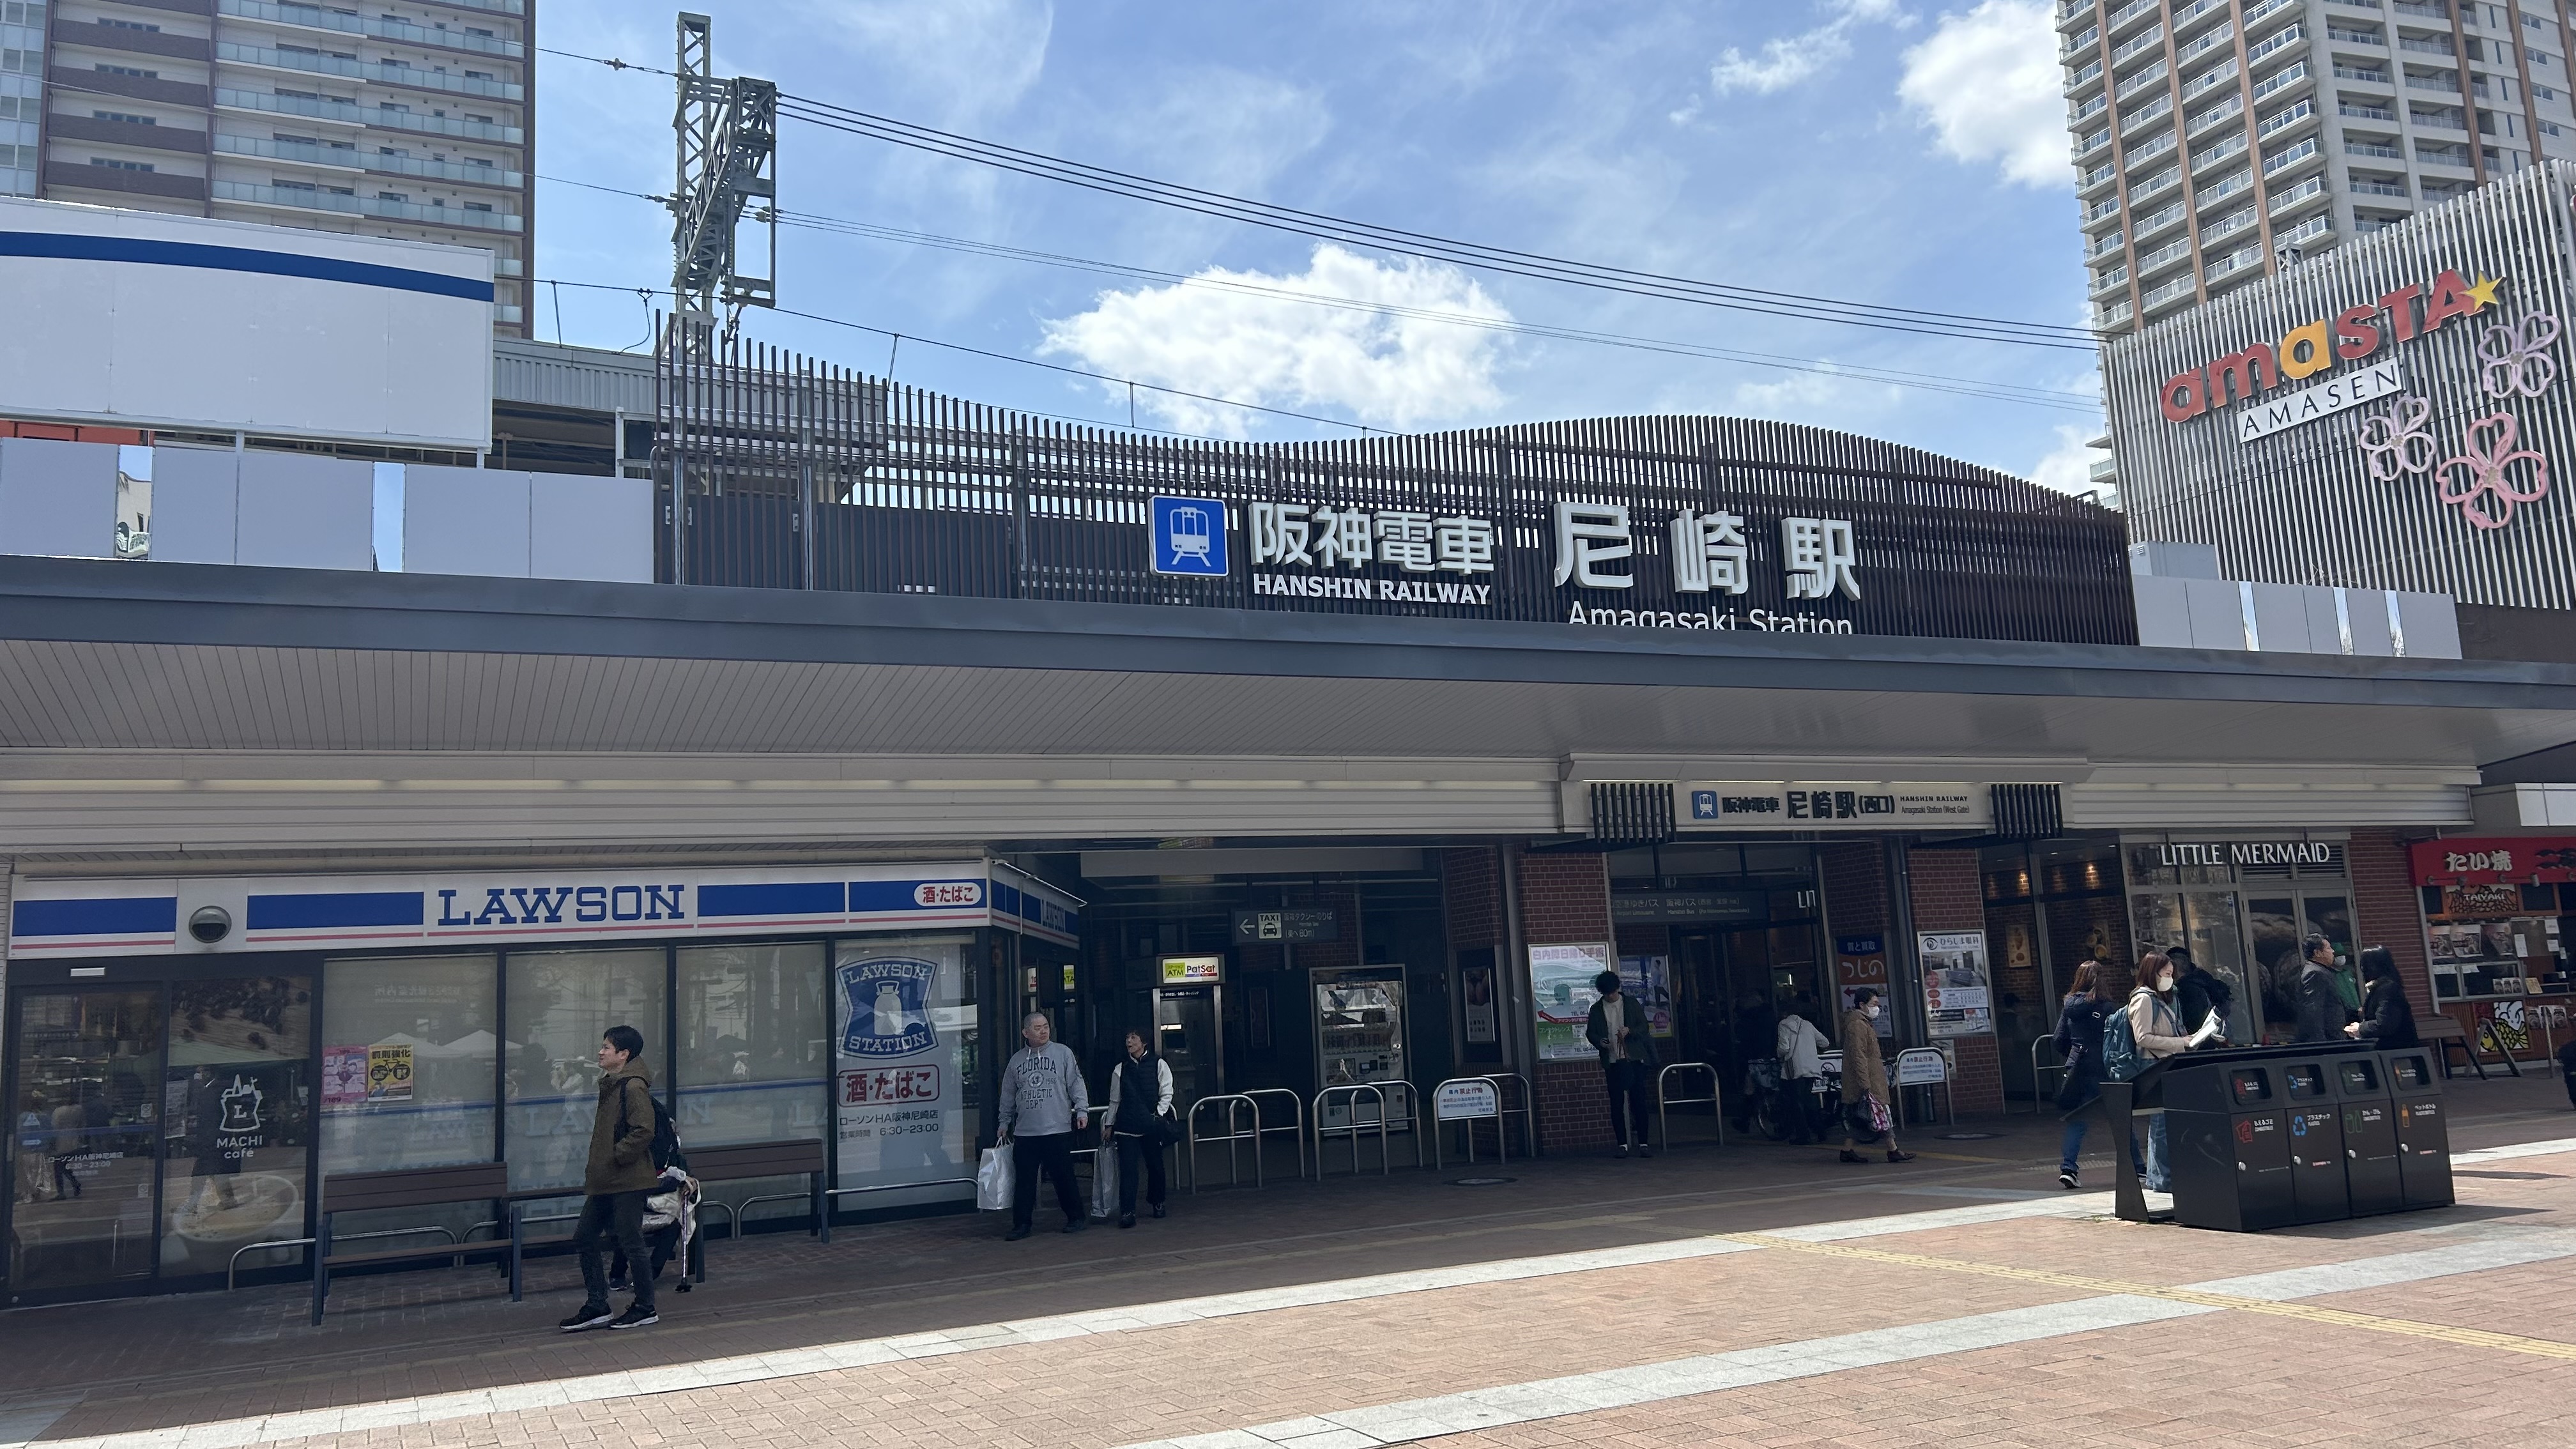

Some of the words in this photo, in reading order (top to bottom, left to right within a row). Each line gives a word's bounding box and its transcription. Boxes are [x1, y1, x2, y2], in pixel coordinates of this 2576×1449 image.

[2242, 364, 2398, 438] AMASEN
[1248, 502, 1494, 574] 阪神電車
[1554, 501, 1860, 601] 尼崎駅
[1254, 573, 1372, 599] HANSHIN
[1379, 579, 1491, 605] RAILWAY
[1749, 608, 1852, 634] Station
[1722, 797, 1781, 813] 阪神電車
[1943, 805, 1956, 813] (West
[1957, 805, 1970, 813] Gate)
[2160, 844, 2223, 865] LITTLE
[2232, 843, 2330, 864] MERMAID
[2446, 850, 2513, 871] たい焼
[438, 884, 684, 926] LAWSON
[2463, 893, 2504, 901] TAIYAKI
[848, 964, 927, 984] LAWSON
[1187, 965, 1215, 973] PatSat
[1842, 959, 1884, 978] つじの
[848, 1031, 927, 1053] STATION
[1017, 1057, 1057, 1079] FLORIDA
[1026, 1099, 1043, 1110] DEPT
[840, 1109, 939, 1126] ローソンHA阪神尼崎店
[217, 1135, 263, 1148] MACHI
[224, 1147, 254, 1159] café
